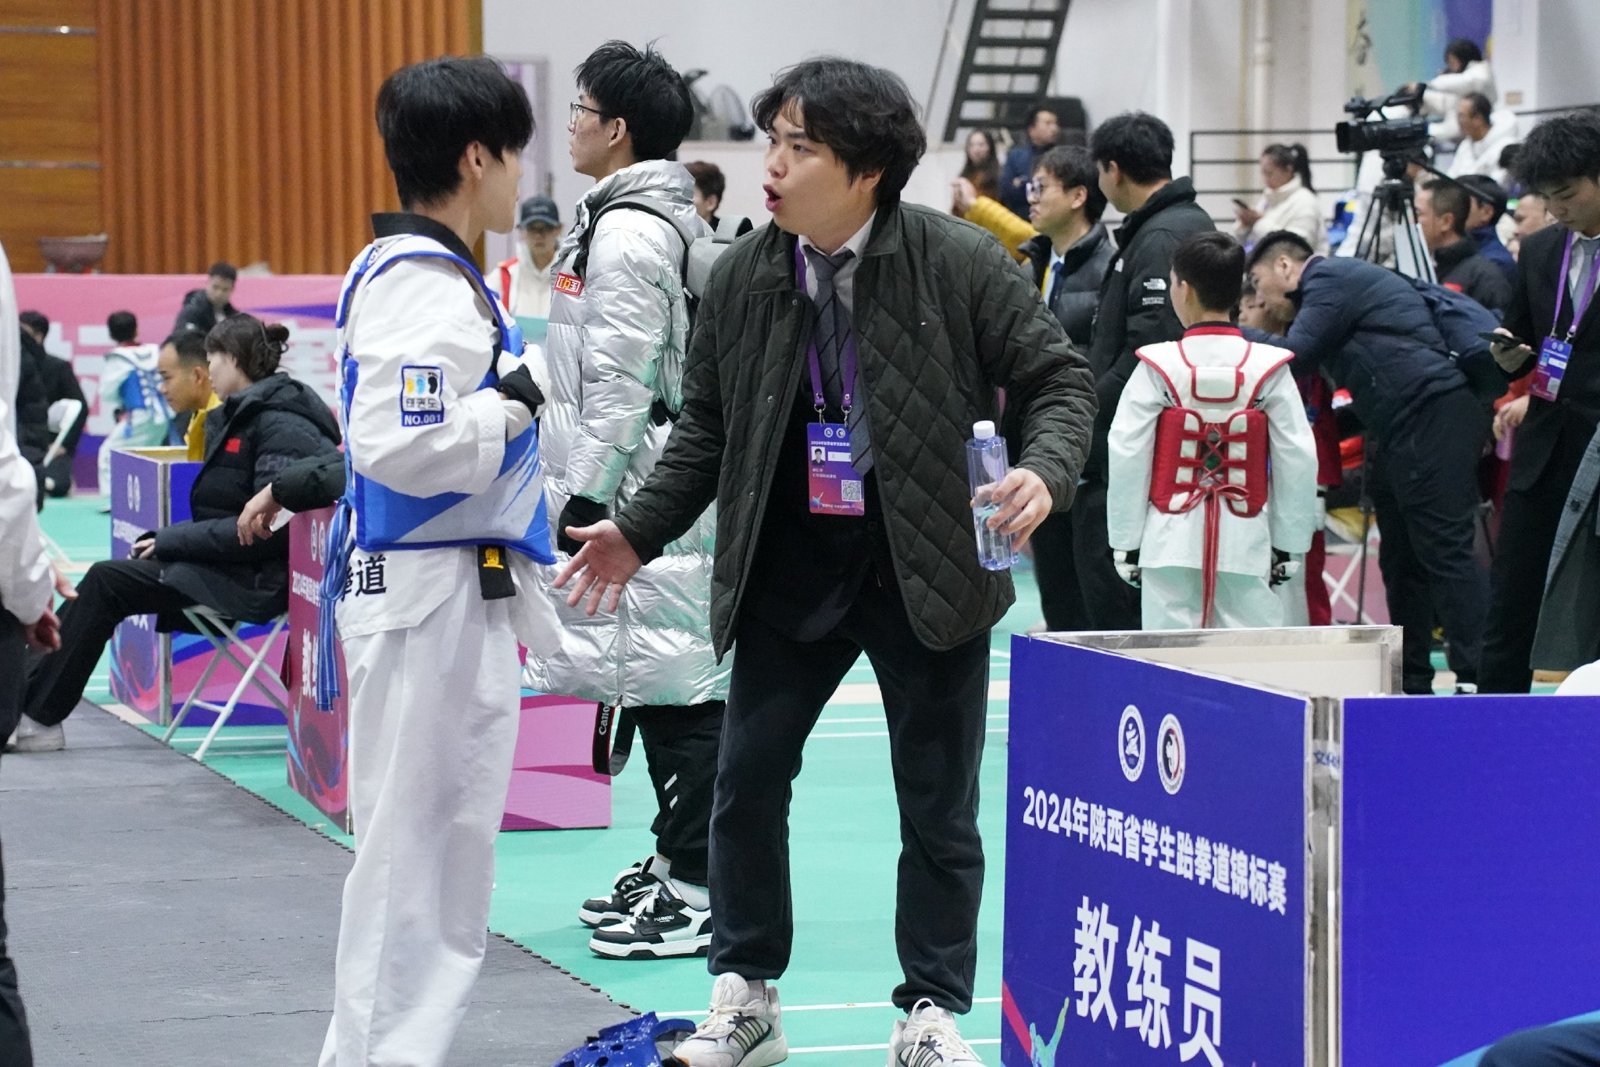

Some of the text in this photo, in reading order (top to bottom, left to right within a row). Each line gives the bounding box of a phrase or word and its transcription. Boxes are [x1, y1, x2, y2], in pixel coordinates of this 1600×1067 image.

[404, 414, 441, 425] NO.001
[1022, 786, 1287, 916] 2024年陕西省学生跆拳道锦标赛
[1072, 895, 1224, 1067] 教练员
